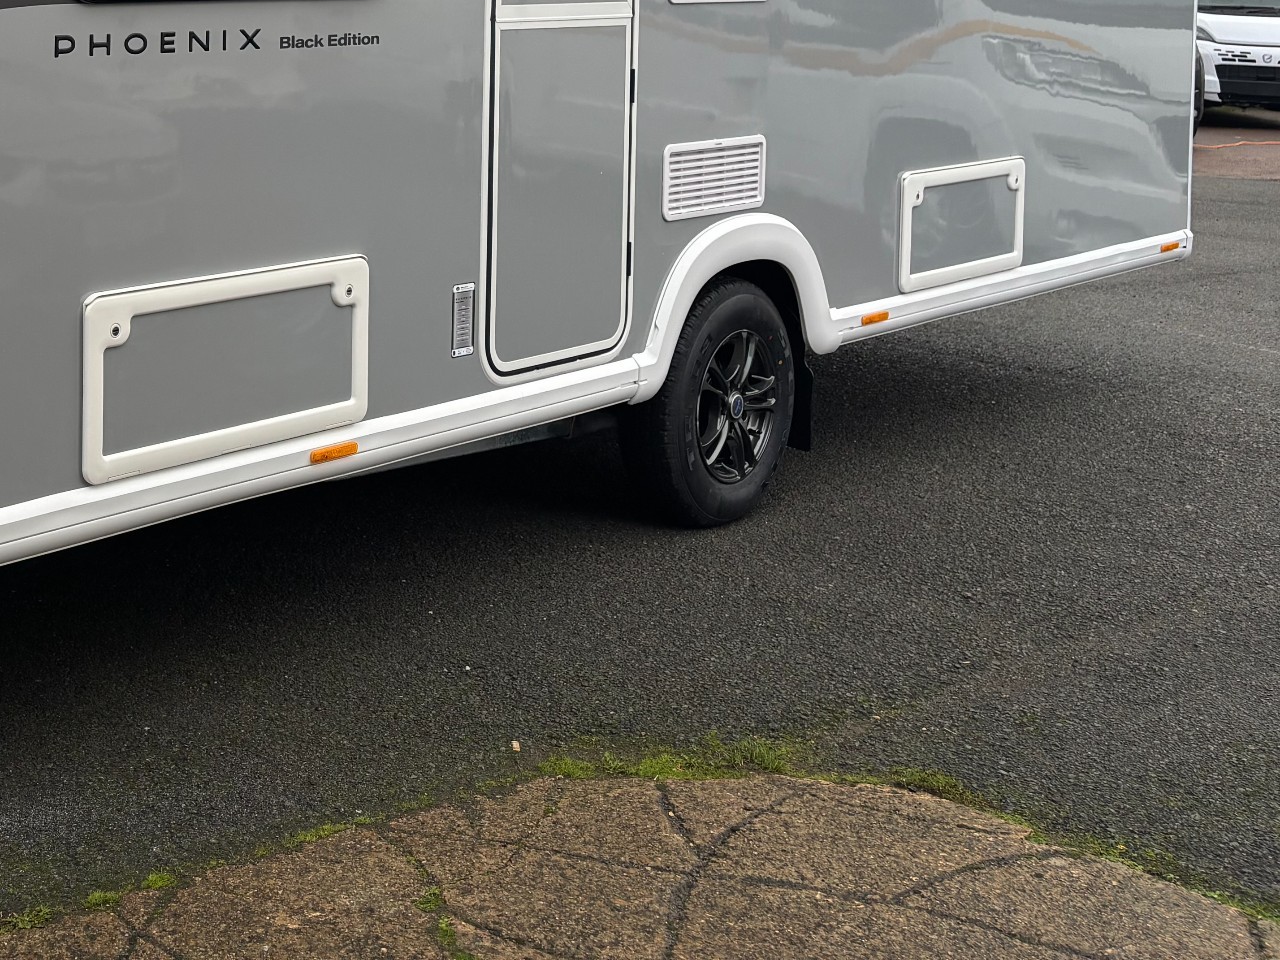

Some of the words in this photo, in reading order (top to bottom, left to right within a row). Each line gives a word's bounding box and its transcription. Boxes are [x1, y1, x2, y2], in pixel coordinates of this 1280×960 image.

[54, 28, 262, 58] PHOENIX
[279, 34, 325, 50] Black
[327, 32, 380, 47] Edition
